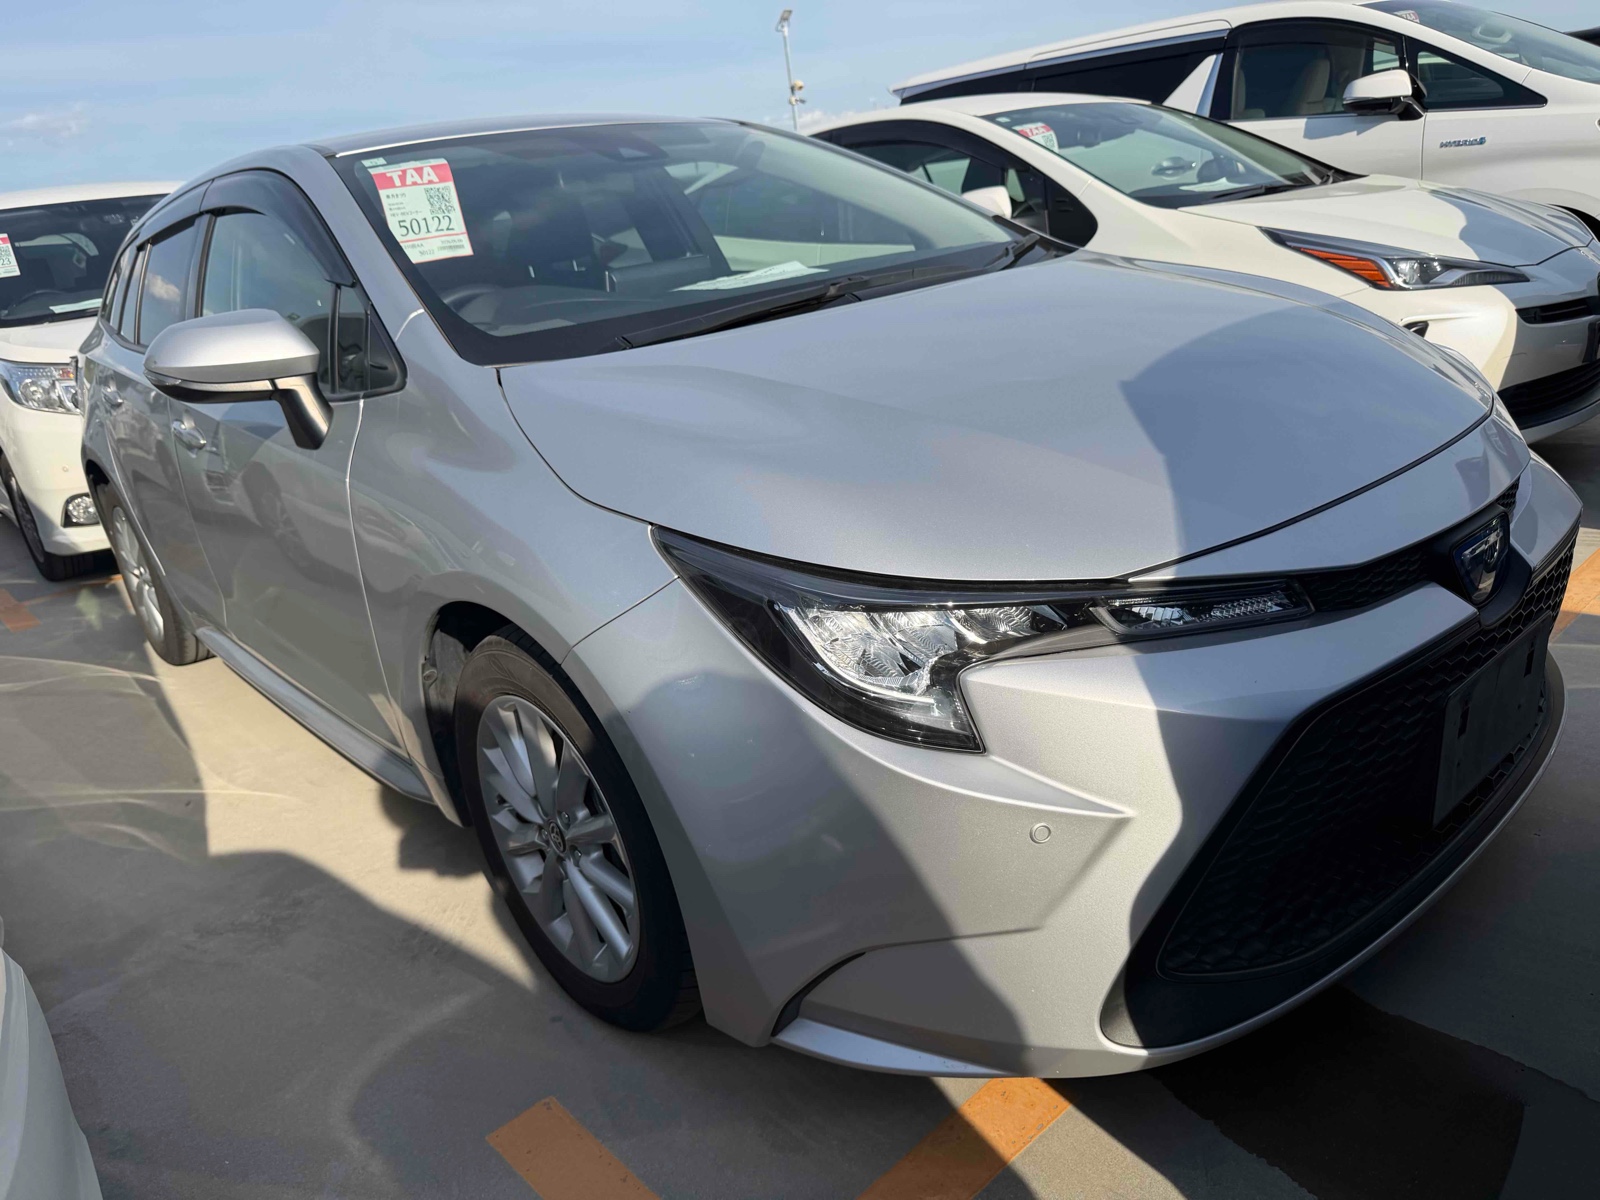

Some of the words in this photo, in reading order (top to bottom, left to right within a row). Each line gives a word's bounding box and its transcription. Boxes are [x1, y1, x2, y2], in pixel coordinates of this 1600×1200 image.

[1023, 127, 1047, 136] TAA
[386, 166, 440, 187] TAA
[398, 215, 455, 237] 50122
